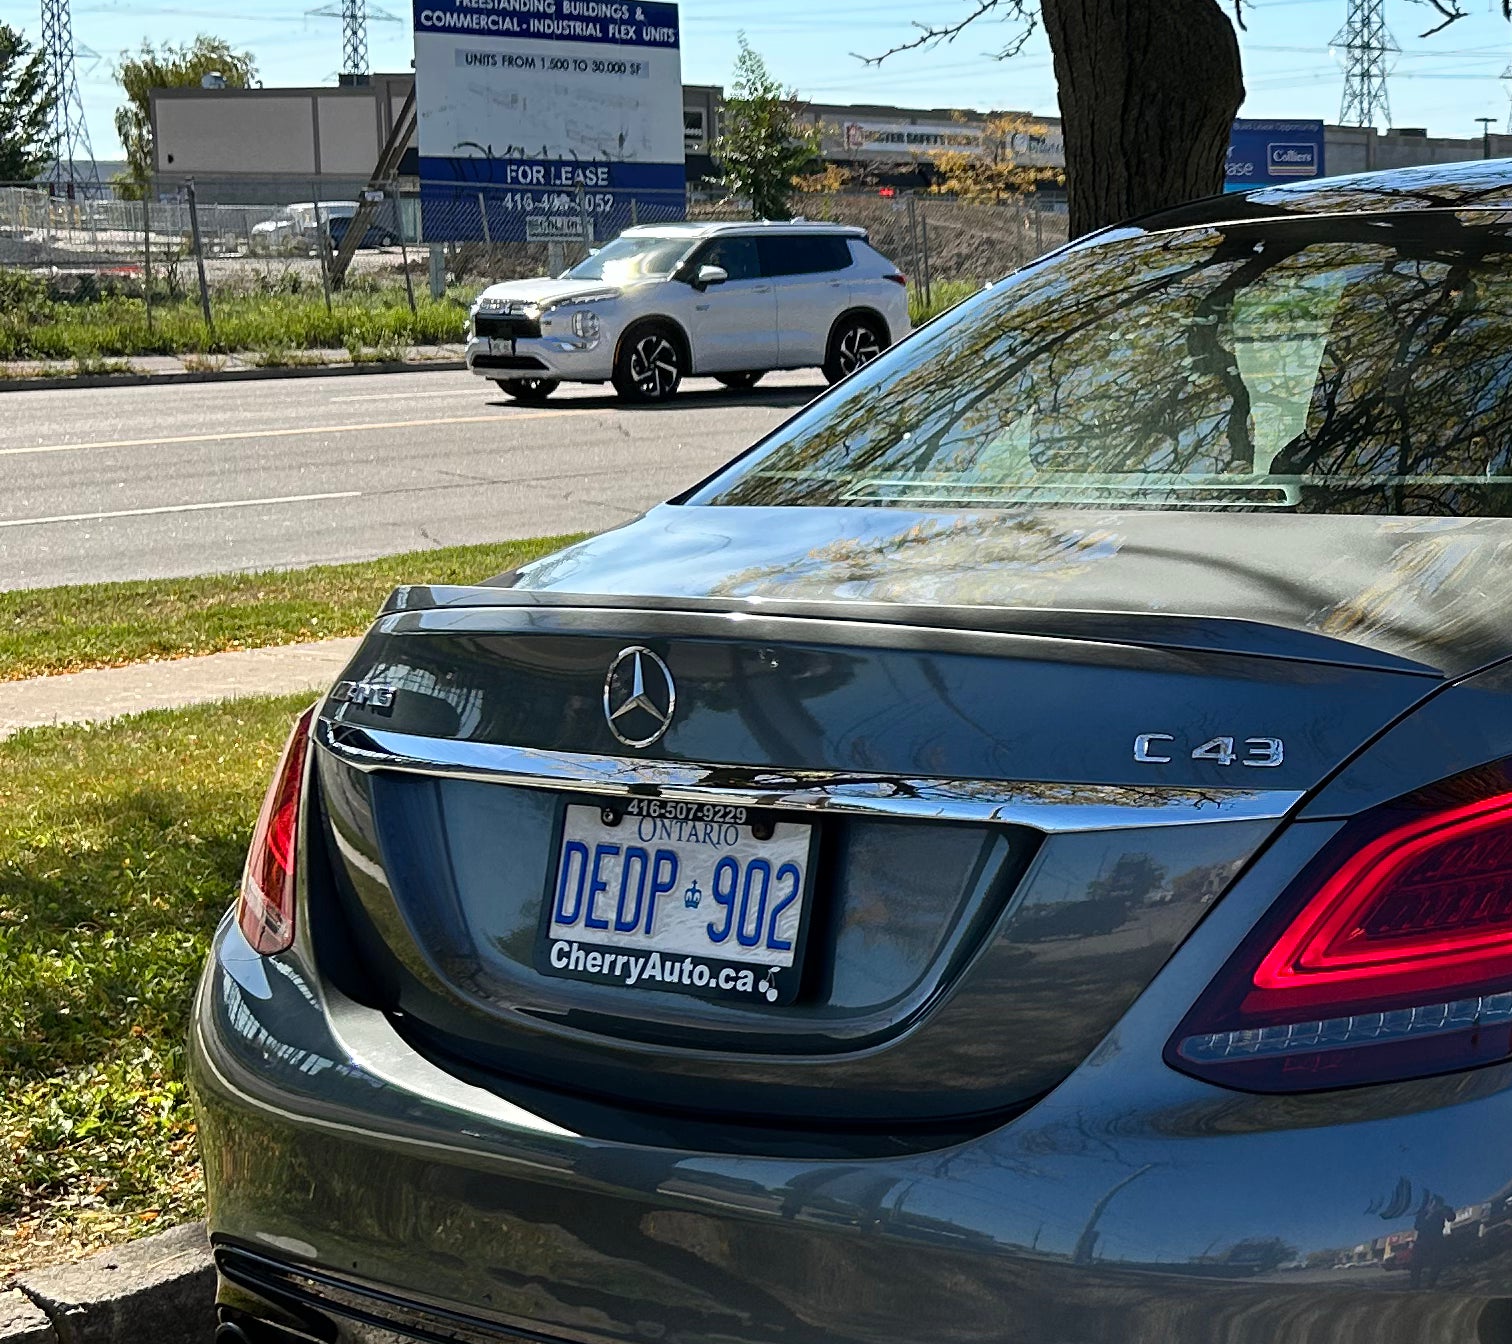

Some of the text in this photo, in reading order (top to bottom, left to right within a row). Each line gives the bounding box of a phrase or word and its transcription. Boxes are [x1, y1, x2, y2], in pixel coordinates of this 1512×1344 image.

[420, 10, 675, 43] COMMERCIAL INDUSTRIAL FLEX UNITS
[563, 0, 629, 21] BUILDINGS
[635, 6, 645, 21] &
[465, 53, 497, 67] UNITS
[501, 55, 535, 71] FROM
[573, 59, 588, 73] TO
[507, 165, 609, 186] FOR LEASE
[1134, 733, 1284, 767] C 43
[627, 799, 747, 824] 416-507-9229
[638, 816, 739, 848] ONTARIO
[554, 840, 801, 951] DEDP 902
[550, 940, 754, 992] CherryAuto.ca
